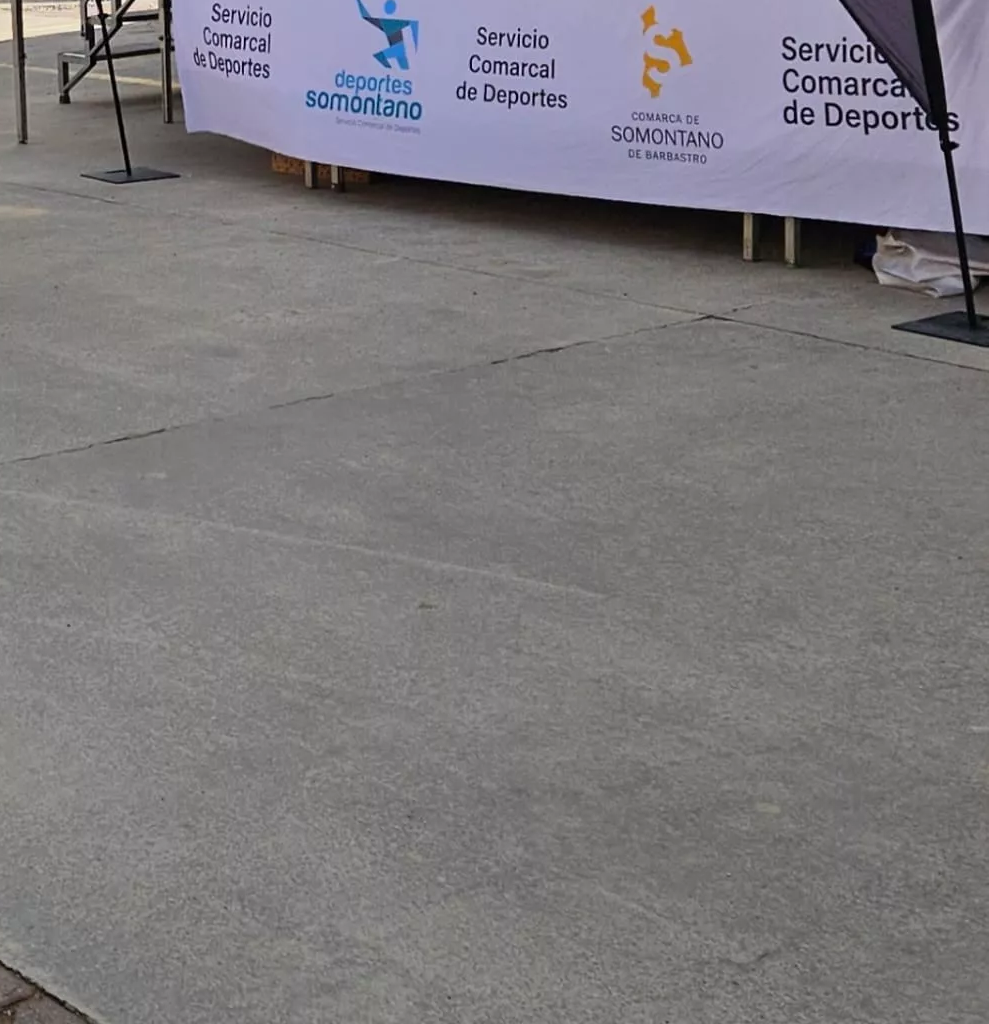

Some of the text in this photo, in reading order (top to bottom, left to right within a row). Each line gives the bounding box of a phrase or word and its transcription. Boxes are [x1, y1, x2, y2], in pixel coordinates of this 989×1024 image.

[211, 2, 272, 28] Servicio
[203, 26, 272, 54] Comarcal
[476, 27, 550, 50] Servicio
[193, 47, 271, 79] de Deportes
[469, 54, 555, 79] Comarcal
[335, 69, 413, 95] deportes
[782, 69, 907, 98] Comarca
[305, 89, 423, 121] somontano
[455, 81, 568, 110] de Deportes
[631, 111, 700, 125] COMARCA DE
[783, 100, 815, 126] de
[610, 125, 724, 150] SOMONTANO
[627, 149, 707, 165] DE BARBASTRO
